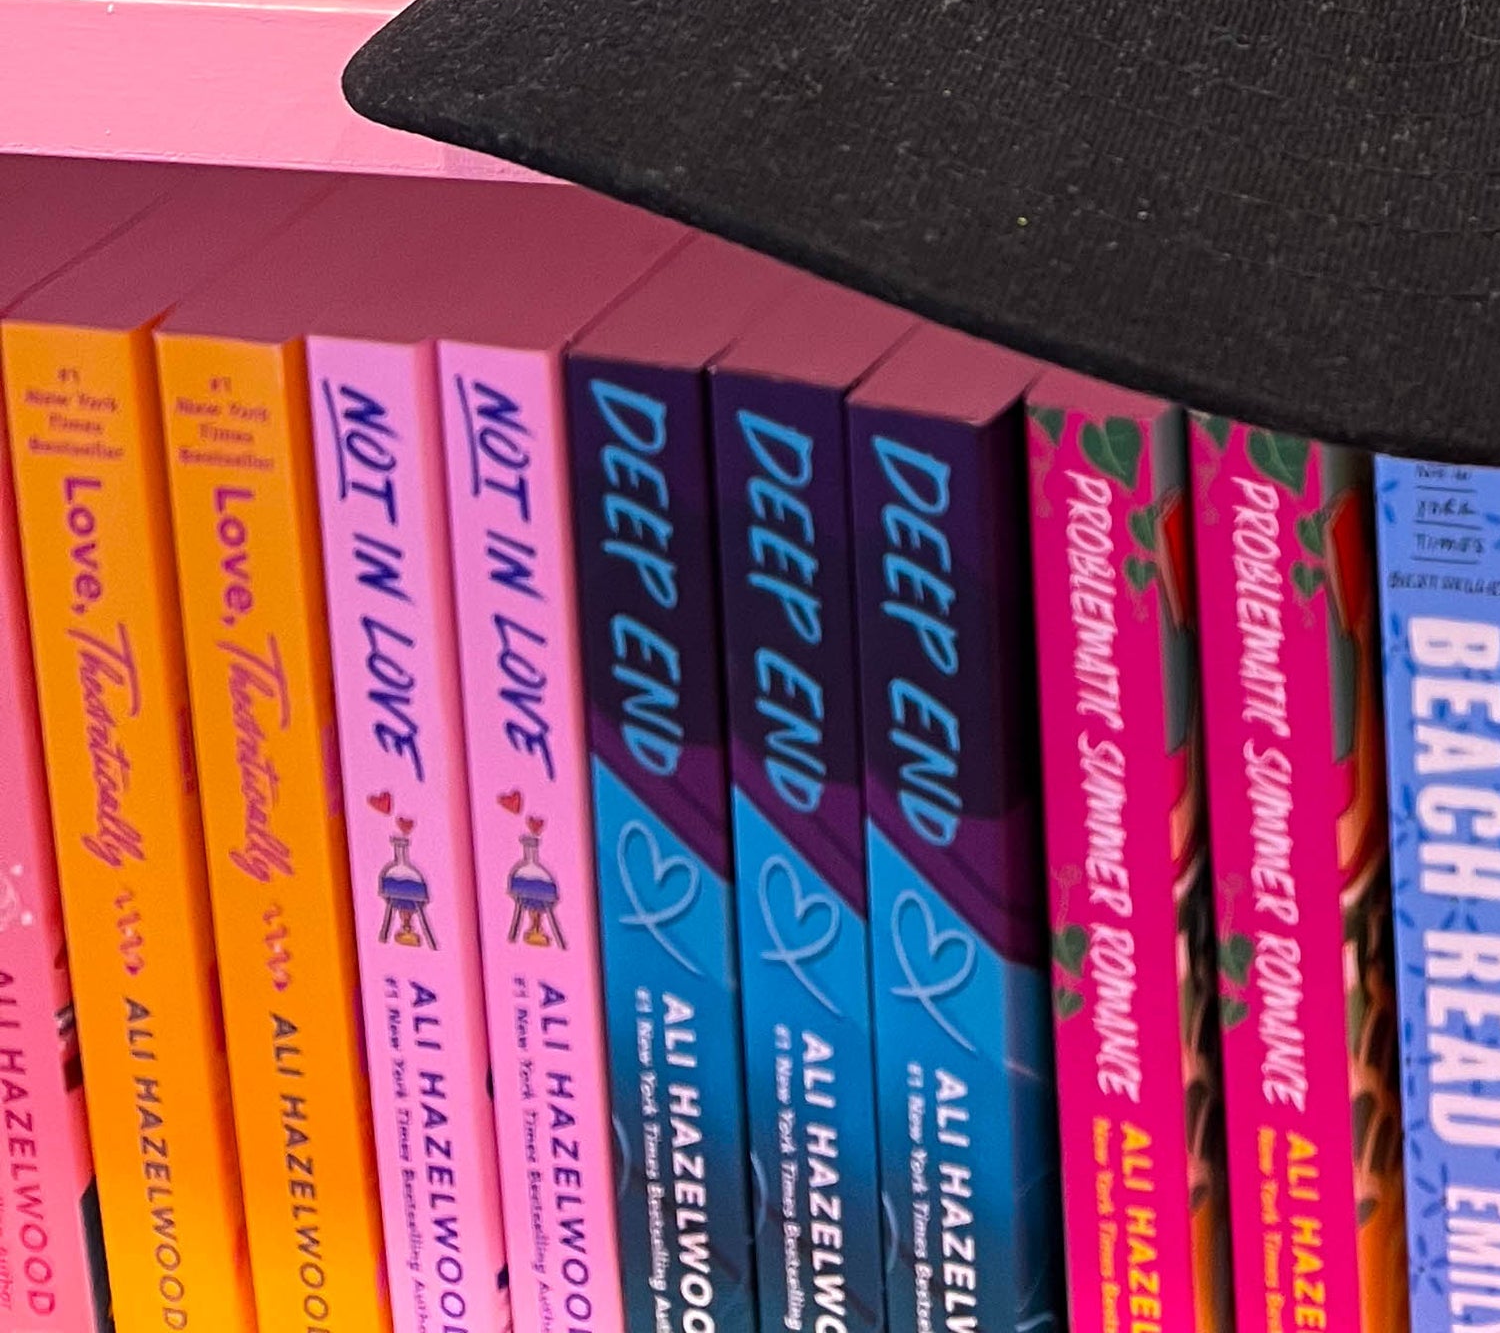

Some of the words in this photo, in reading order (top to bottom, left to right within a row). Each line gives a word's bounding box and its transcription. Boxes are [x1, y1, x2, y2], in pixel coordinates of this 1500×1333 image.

[340, 384, 398, 526] NOT
[473, 380, 532, 523] NOT
[590, 378, 677, 609] DEEP
[63, 476, 102, 614] Love,
[213, 487, 255, 628] Love,
[353, 532, 414, 605] IN
[486, 529, 547, 601] IN
[736, 409, 822, 645] DEEP
[872, 434, 959, 676] DEEP
[1064, 469, 1124, 732] PROBLEMATIC
[1230, 476, 1291, 740] PROBLEMATIC
[361, 614, 425, 783] LOVE
[494, 613, 556, 781] LOVE
[610, 614, 684, 776] END
[754, 646, 827, 814] END
[888, 677, 964, 847] END
[1077, 730, 1133, 918] SUMMER
[1243, 738, 1300, 926] SUMMER
[124, 997, 157, 1062] ALI
[270, 1012, 305, 1079] ALI
[387, 1009, 403, 1052] New
[408, 979, 442, 1052] ALI
[538, 979, 570, 1053] ALI
[636, 1018, 653, 1068] New
[661, 990, 698, 1069] ALI
[801, 1031, 836, 1108] ALI
[1089, 922, 1142, 1104] ROMANCE
[1255, 931, 1309, 1113] ROMANCE
[638, 1073, 658, 1117] York
[643, 1123, 662, 1180] Times
[935, 1068, 970, 1147] ALI
[1120, 1121, 1154, 1192] ALI
[1286, 1129, 1320, 1202] ALI
[0, 1048, 56, 1317] HAZELWOOD
[133, 1075, 188, 1331] HAZELWOOD
[646, 1183, 669, 1291] Bestselling
